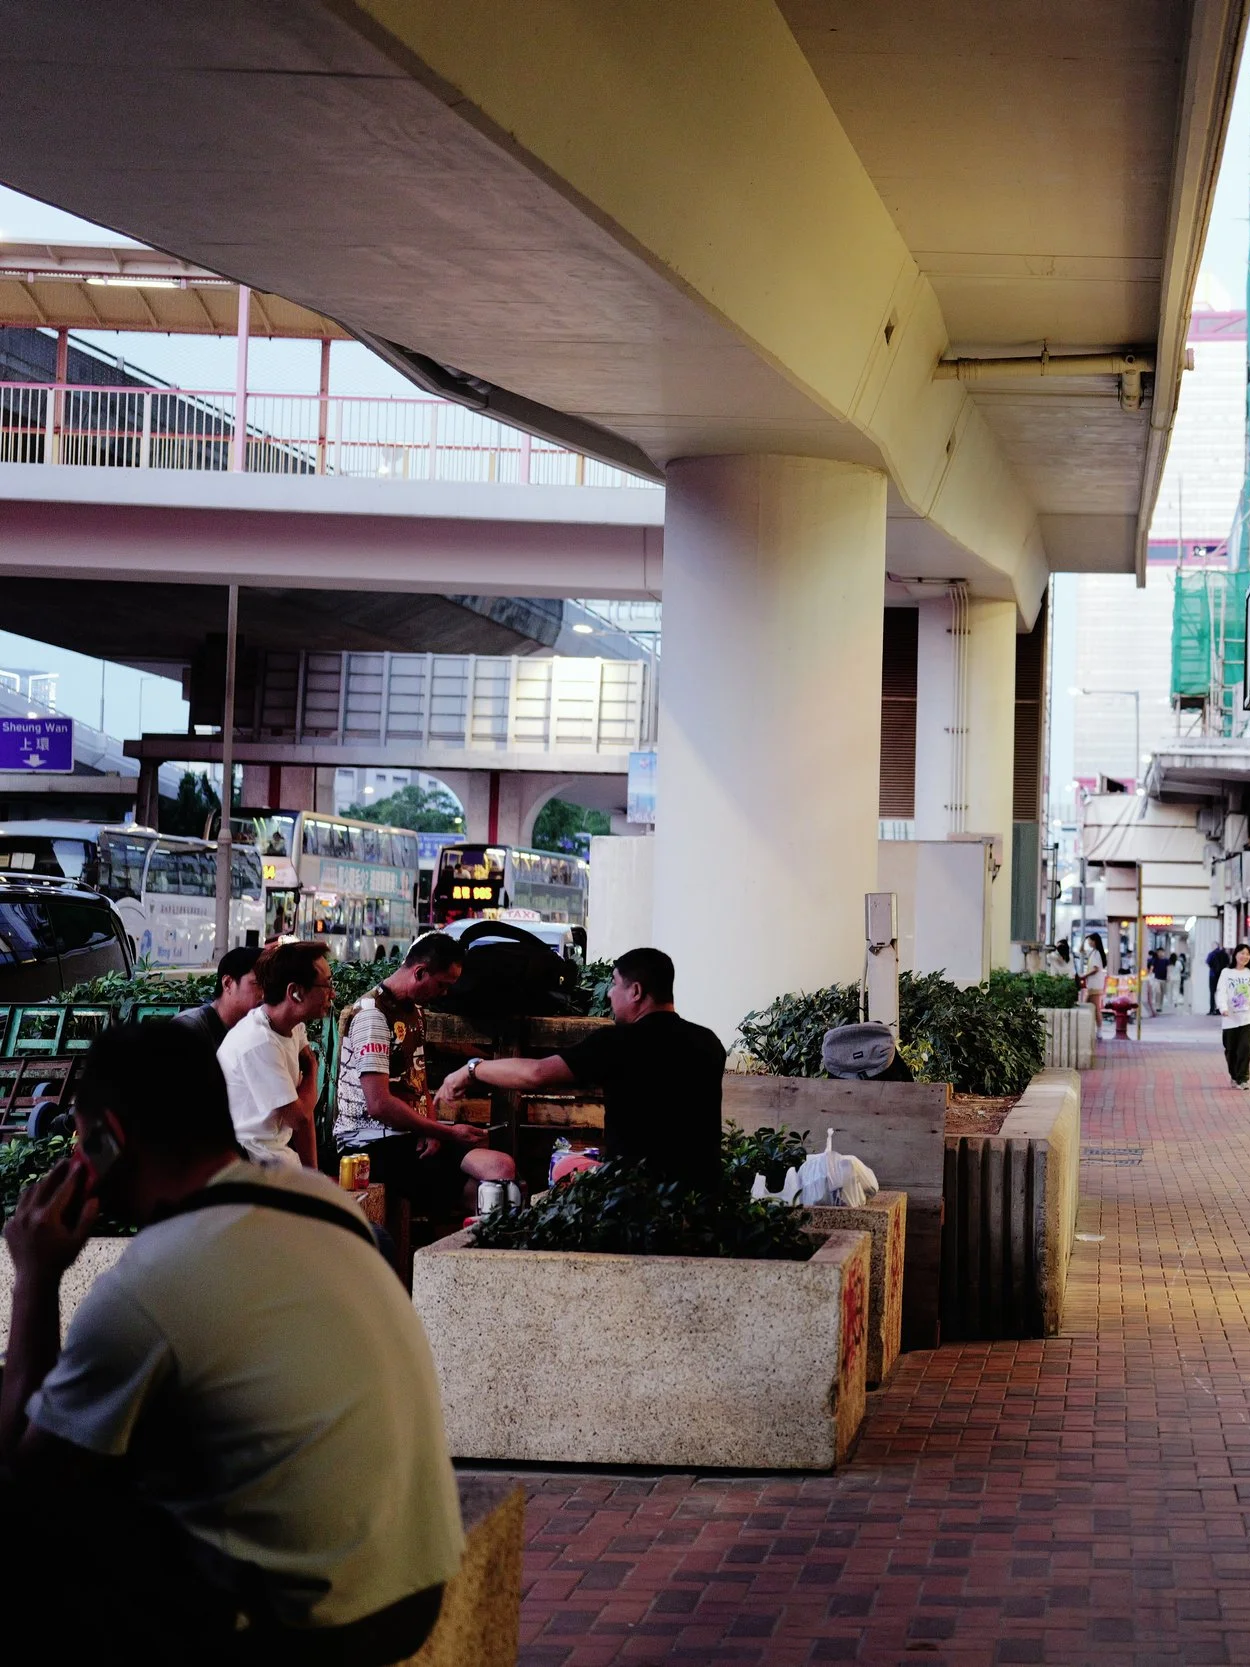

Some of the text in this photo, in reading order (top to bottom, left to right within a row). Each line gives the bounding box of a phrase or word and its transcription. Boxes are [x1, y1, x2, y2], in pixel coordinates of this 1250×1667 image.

[2, 721, 68, 735] Sheung Wan
[20, 736, 50, 752] 上環
[507, 909, 536, 919] TAXI
